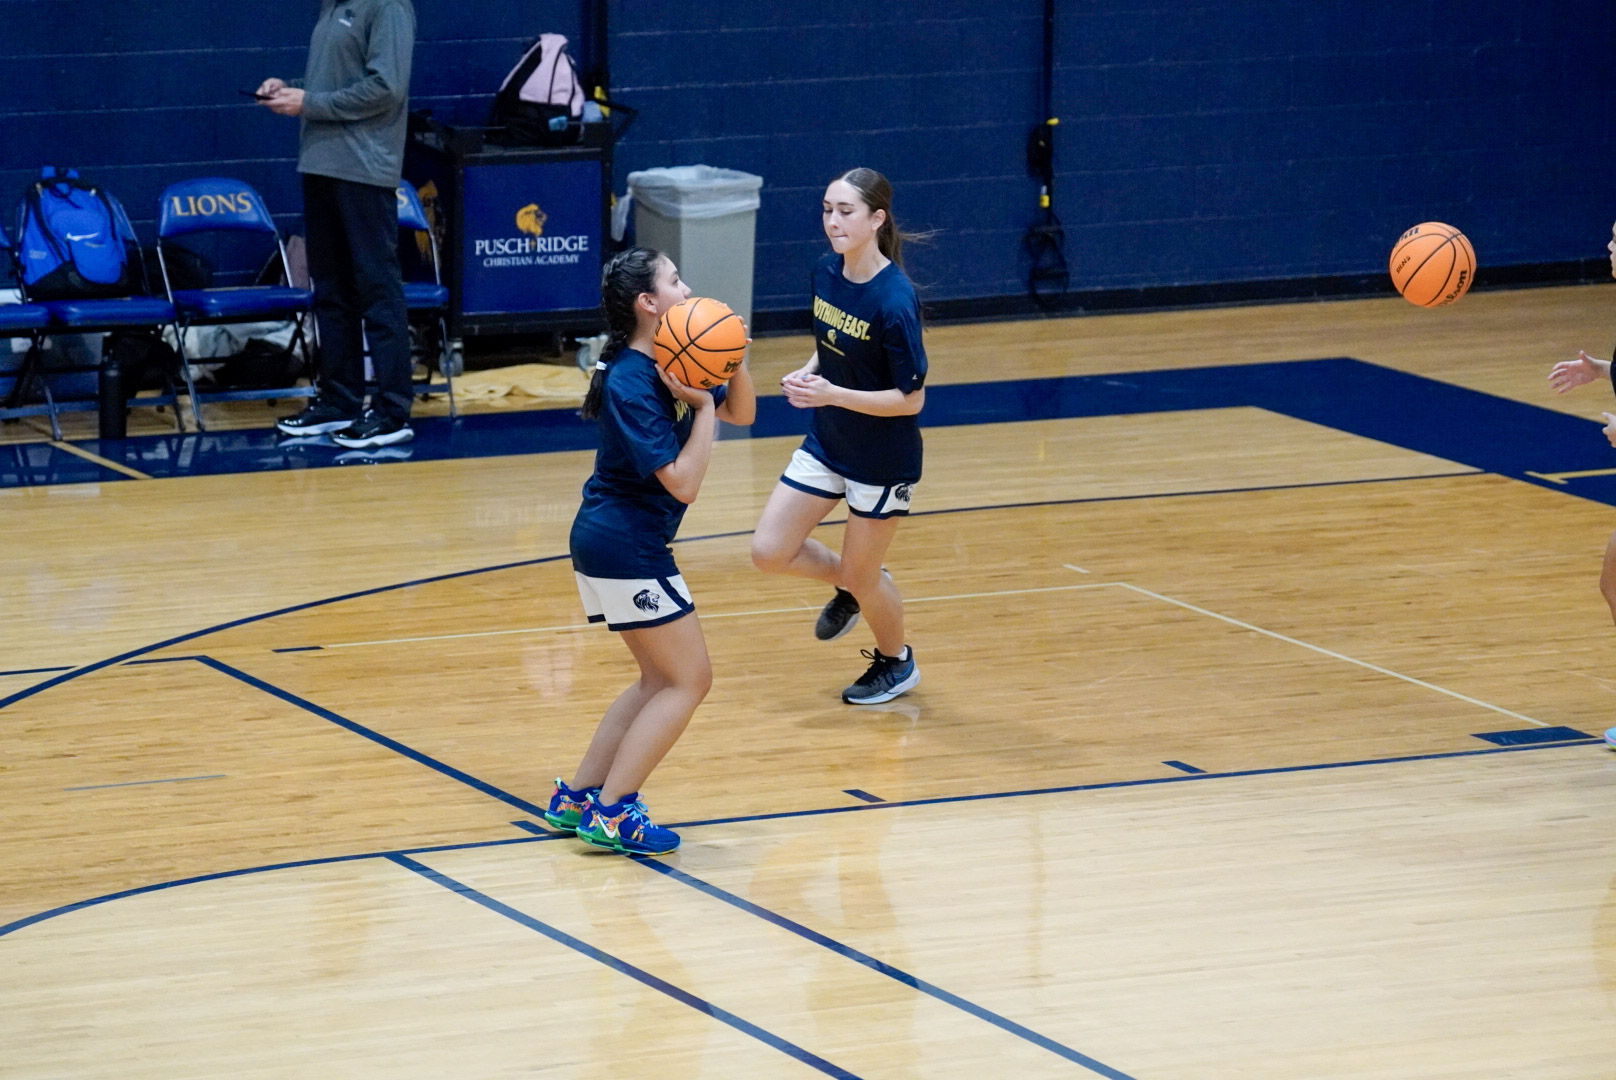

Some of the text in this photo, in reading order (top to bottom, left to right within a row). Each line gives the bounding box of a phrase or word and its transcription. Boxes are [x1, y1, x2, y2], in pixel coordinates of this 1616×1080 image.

[172, 192, 252, 216] LIONS
[475, 235, 589, 255] PUSCH RIDGE
[483, 253, 579, 268] CHRISTIAN ACADEMY
[842, 314, 871, 340] EASY.
